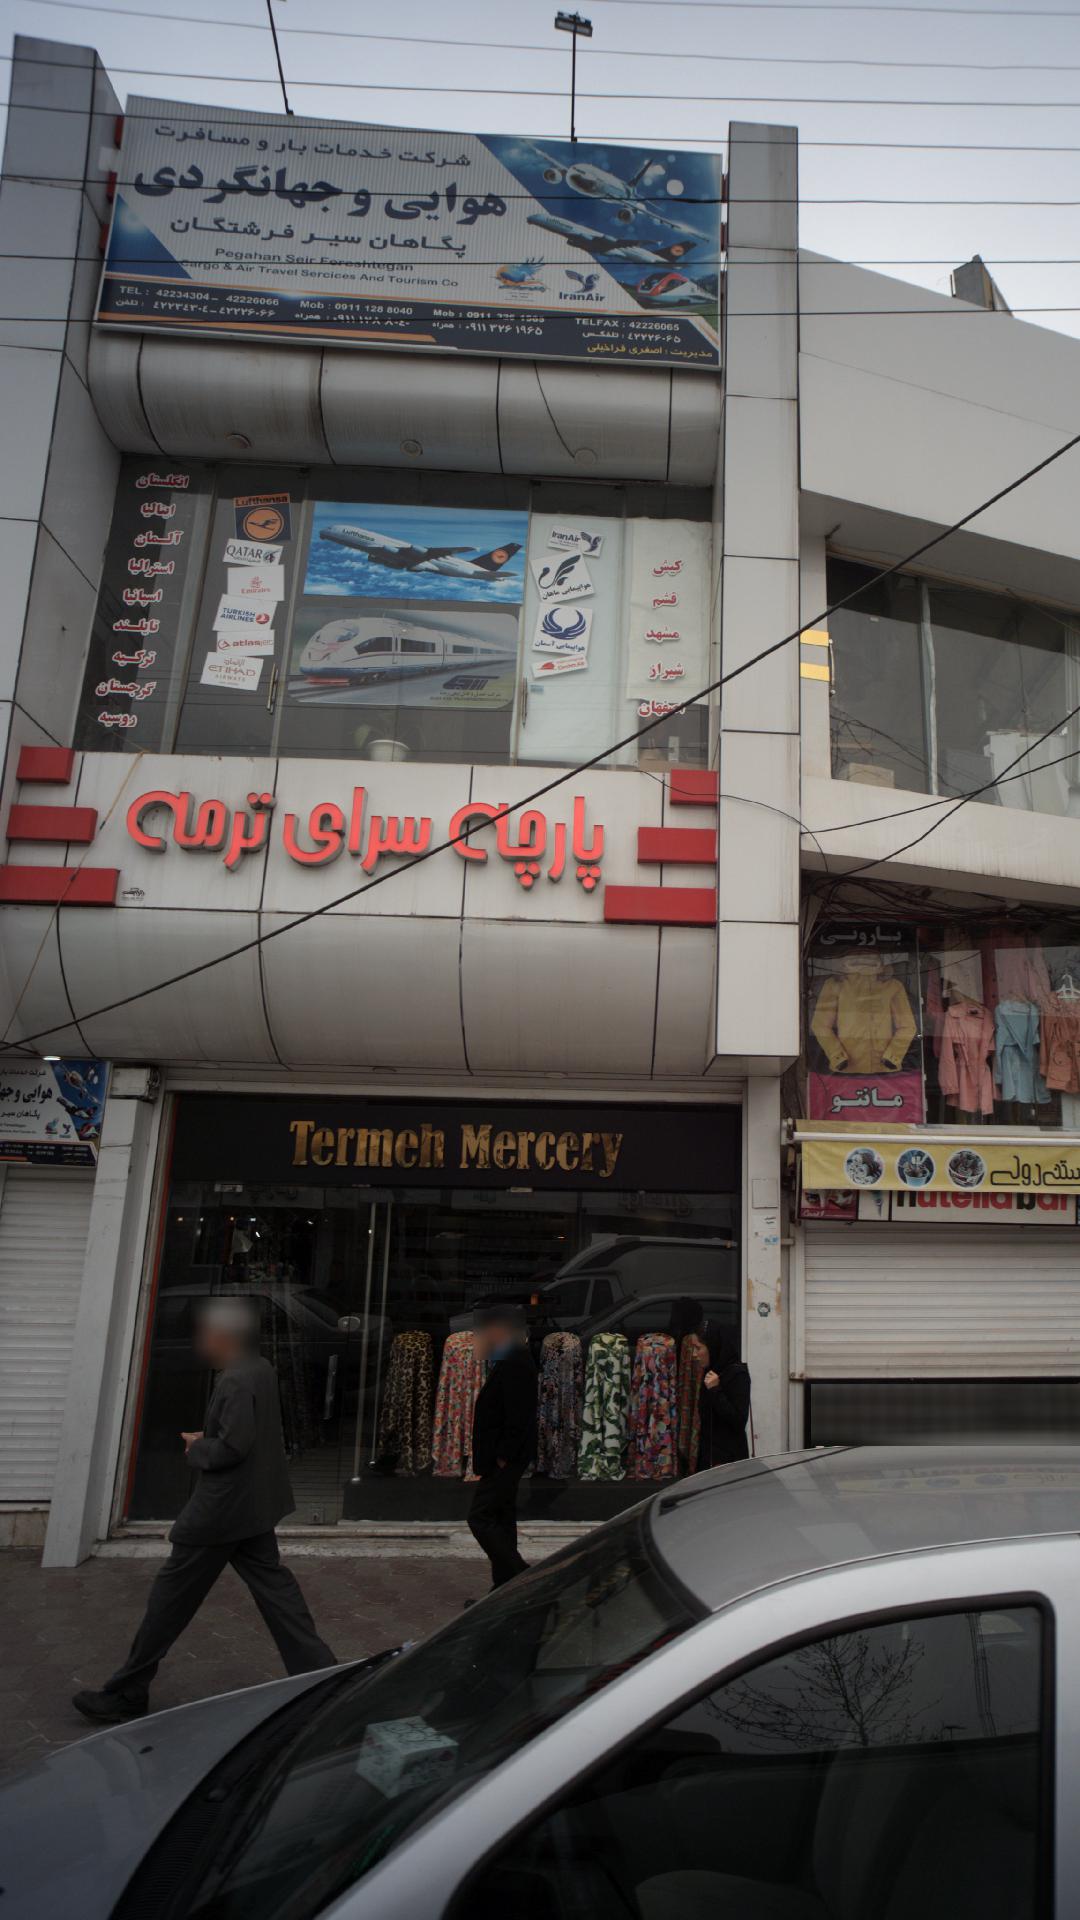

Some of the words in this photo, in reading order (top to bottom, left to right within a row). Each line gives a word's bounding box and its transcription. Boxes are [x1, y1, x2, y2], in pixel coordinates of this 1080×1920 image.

[155, 125, 249, 147] مسافرت
[256, 140, 267, 151] و
[275, 138, 306, 155] بار
[314, 141, 392, 160] خدمات
[399, 152, 471, 168] شرکت
[134, 164, 342, 212] جهانگردی
[346, 188, 372, 217] و
[385, 182, 507, 225] هوایی
[301, 230, 361, 247] سیر
[216, 248, 281, 263] Pegahan
[223, 262, 233, 271] &
[236, 263, 255, 273] Air
[258, 265, 298, 276] Travel
[360, 273, 385, 282] And
[389, 274, 439, 286] Tourism
[120, 286, 142, 296] TEL
[559, 291, 606, 303] IranAir
[300, 301, 325, 310] Mob
[433, 309, 455, 318] Mob
[575, 317, 620, 327] TELFAX
[134, 531, 184, 547] آلمان
[226, 544, 264, 560] QATAR
[653, 592, 678, 607] قشم
[219, 612, 255, 623] AIRLINES
[222, 606, 256, 617] TURKISH
[645, 626, 680, 642] مشهد
[649, 662, 684, 679] شیراز
[98, 711, 138, 727] روسیه
[128, 790, 277, 873] ترمه
[284, 786, 432, 876] سرای
[450, 796, 606, 893] پارچه
[832, 1088, 904, 1113] مانتو
[290, 1120, 445, 1169] Termeh
[459, 1124, 623, 1178] Mercery
